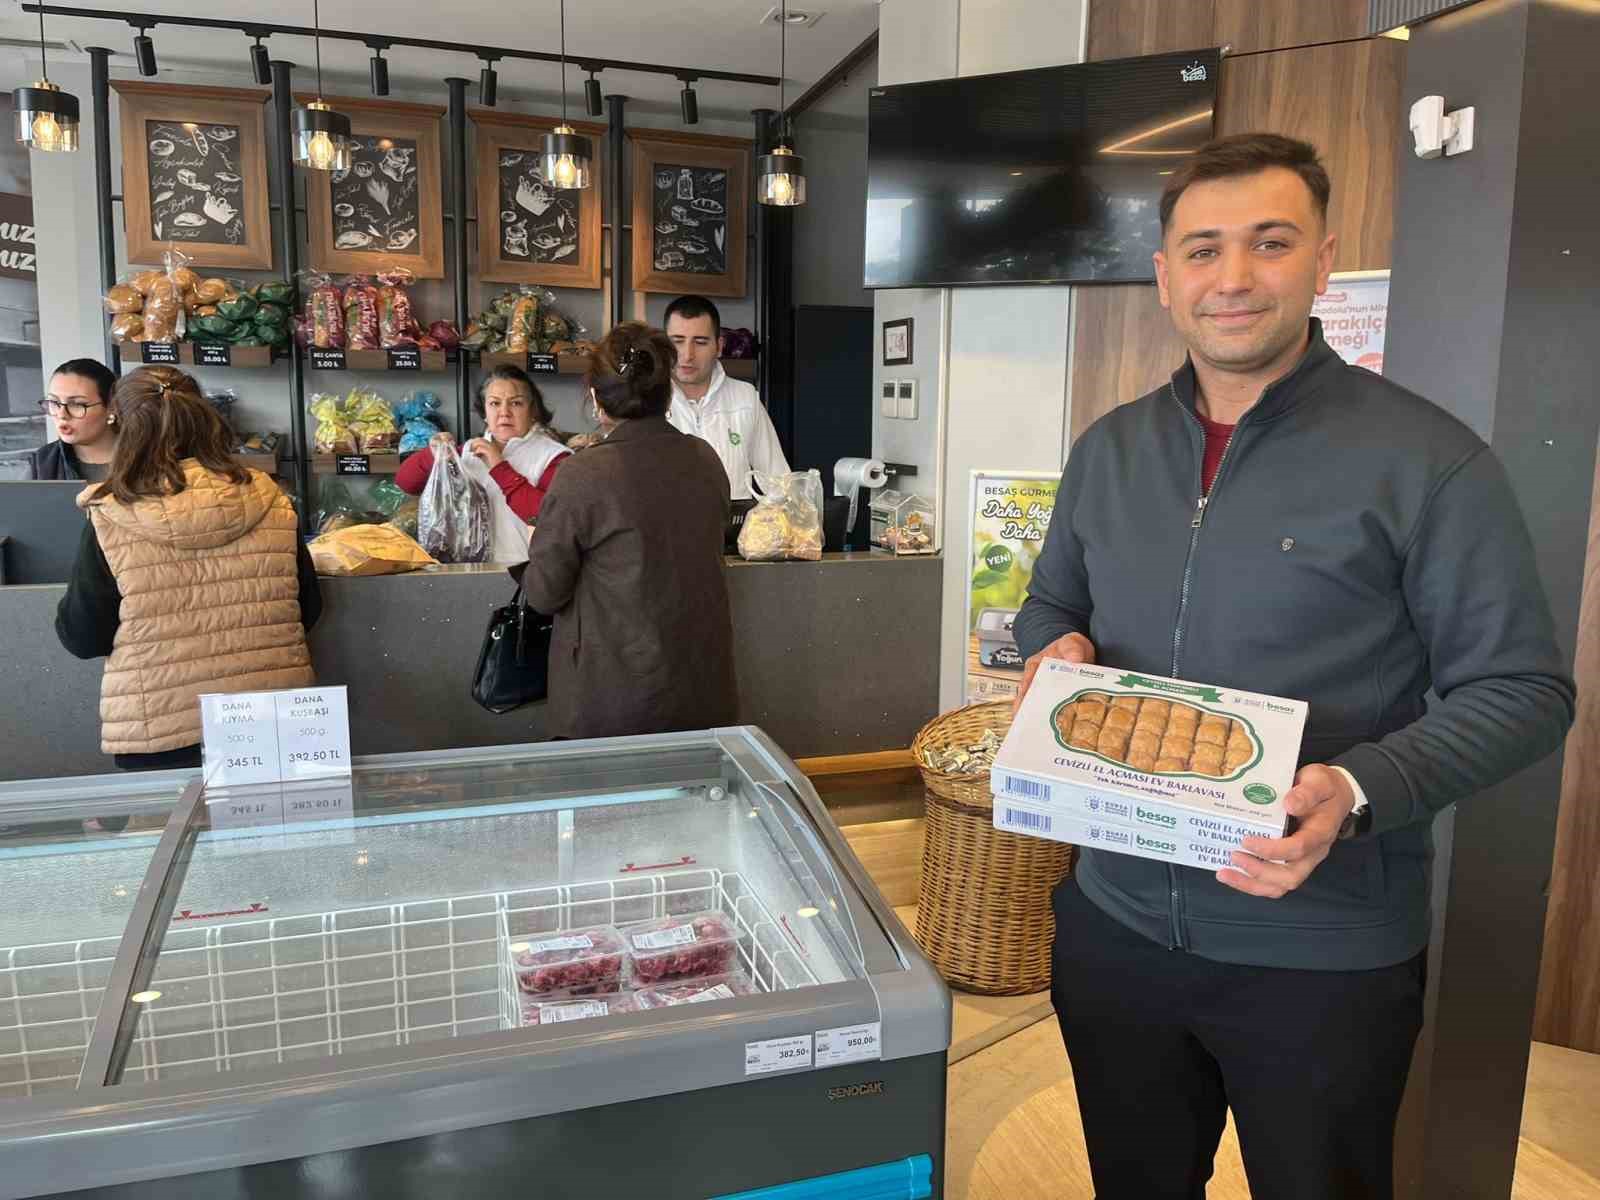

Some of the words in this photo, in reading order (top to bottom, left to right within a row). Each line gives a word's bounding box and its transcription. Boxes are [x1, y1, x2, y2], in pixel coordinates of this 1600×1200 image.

[984, 486, 1017, 498] BESAŞ
[983, 499, 1024, 519] Daha
[1000, 521, 1041, 541] Daha
[294, 695, 324, 705] DANA
[222, 702, 252, 713] DANA
[329, 750, 341, 760] TL
[226, 757, 249, 768] 345
[251, 756, 264, 766] TL
[1054, 756, 1092, 771] CEVİZLİ
[1093, 766, 1106, 774] EL
[1150, 776, 1165, 786] EV
[1166, 779, 1226, 800] BAKLAVASI
[1136, 806, 1177, 826] besaş
[1198, 829, 1209, 837] EV
[1136, 834, 1177, 852] besaş
[1198, 853, 1209, 862] EV
[779, 1047, 806, 1059] 382.50
